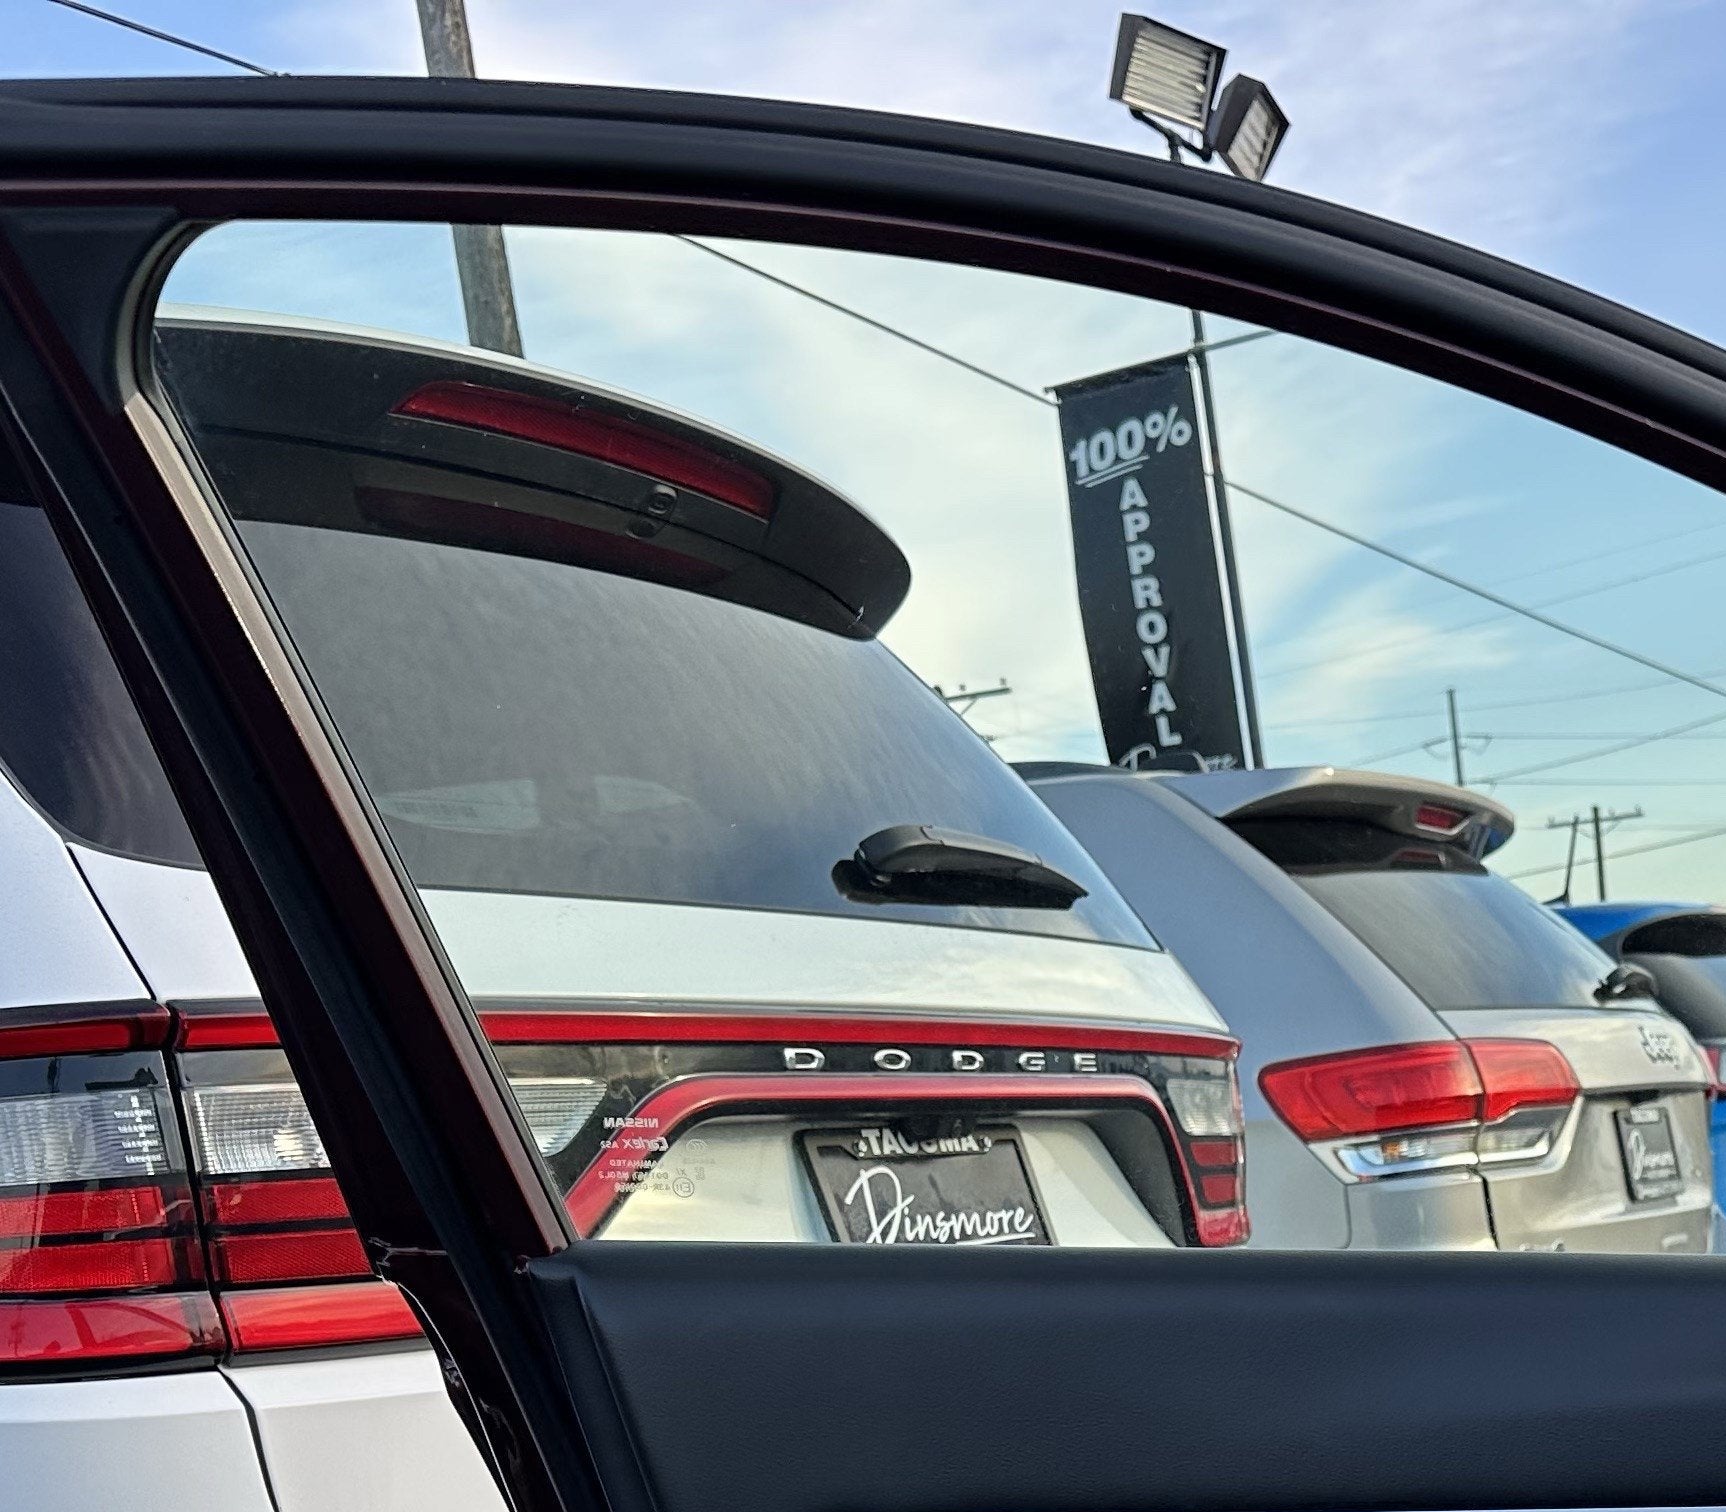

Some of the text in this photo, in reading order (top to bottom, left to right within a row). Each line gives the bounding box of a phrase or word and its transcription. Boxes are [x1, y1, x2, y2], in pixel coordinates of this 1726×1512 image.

[1069, 405, 1192, 478] 100%
[1119, 477, 1182, 748] APPROVAL
[784, 1047, 1097, 1072] DODGE
[844, 1165, 1034, 1244] Dinsmore
